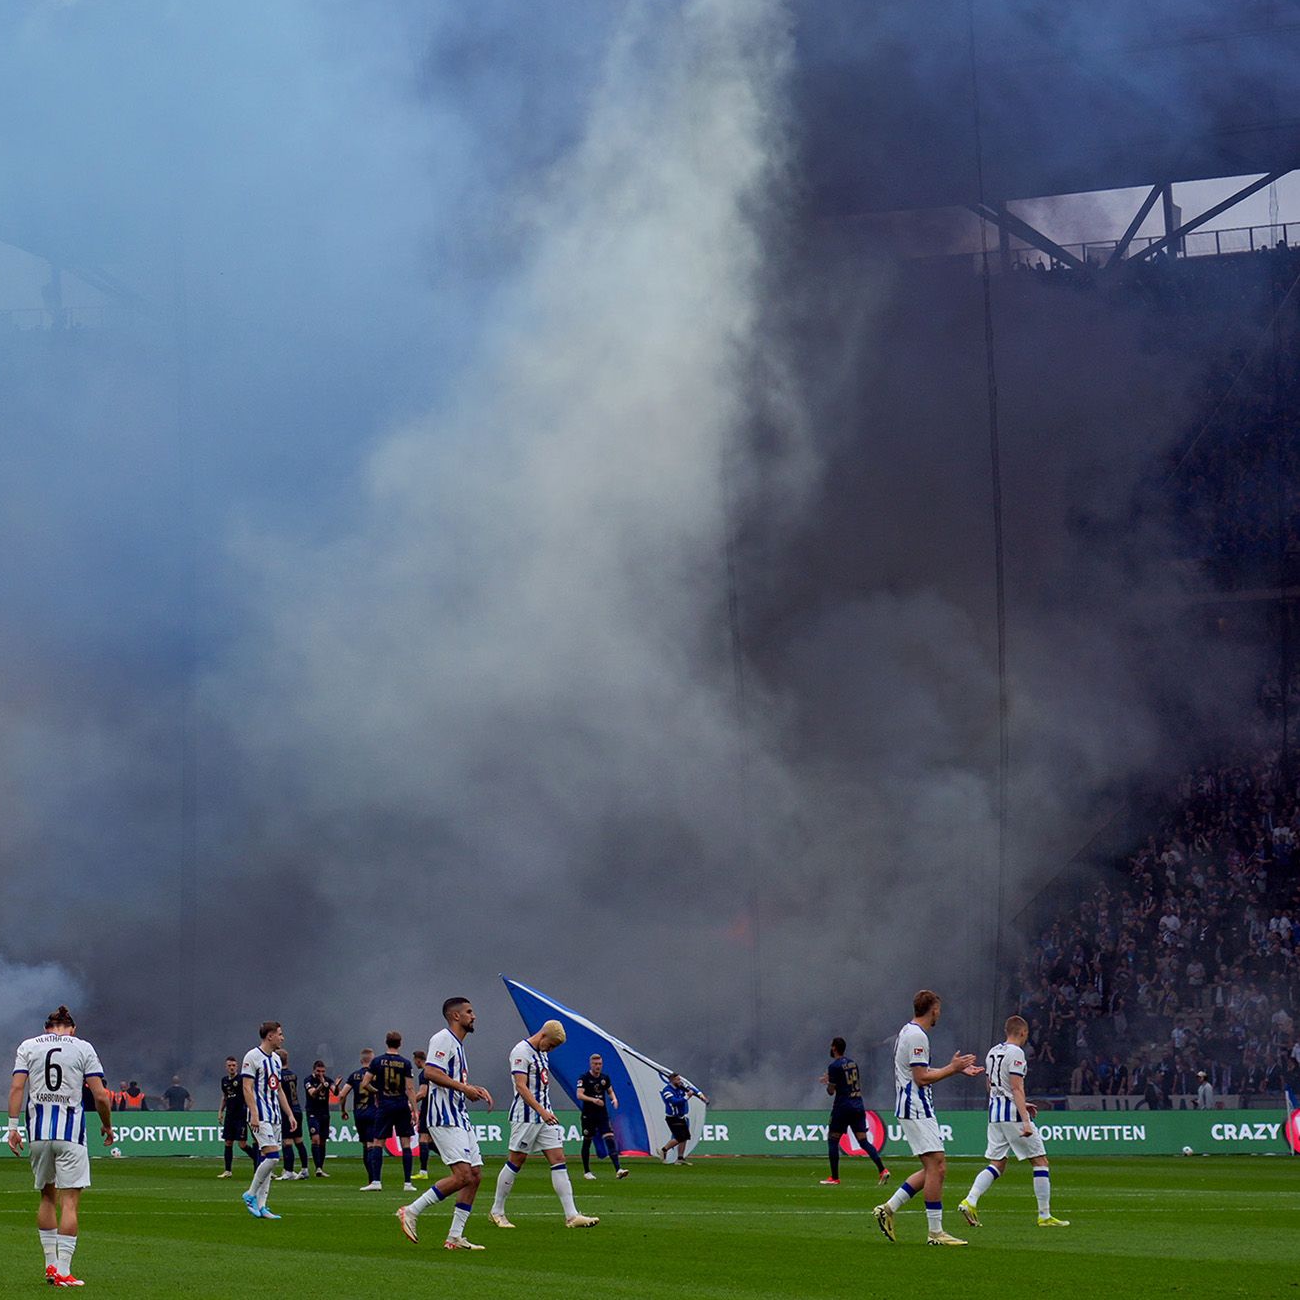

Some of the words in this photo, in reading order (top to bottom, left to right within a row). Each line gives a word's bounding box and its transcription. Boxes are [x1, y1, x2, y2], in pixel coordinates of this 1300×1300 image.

[45, 1048, 62, 1092] 6
[384, 1067, 401, 1091] 14
[989, 1054, 1005, 1087] 27
[112, 1125, 225, 1142] SPORTWETTE
[1039, 1125, 1146, 1141] ORTWETTEN
[1211, 1123, 1281, 1141] CRAZY
